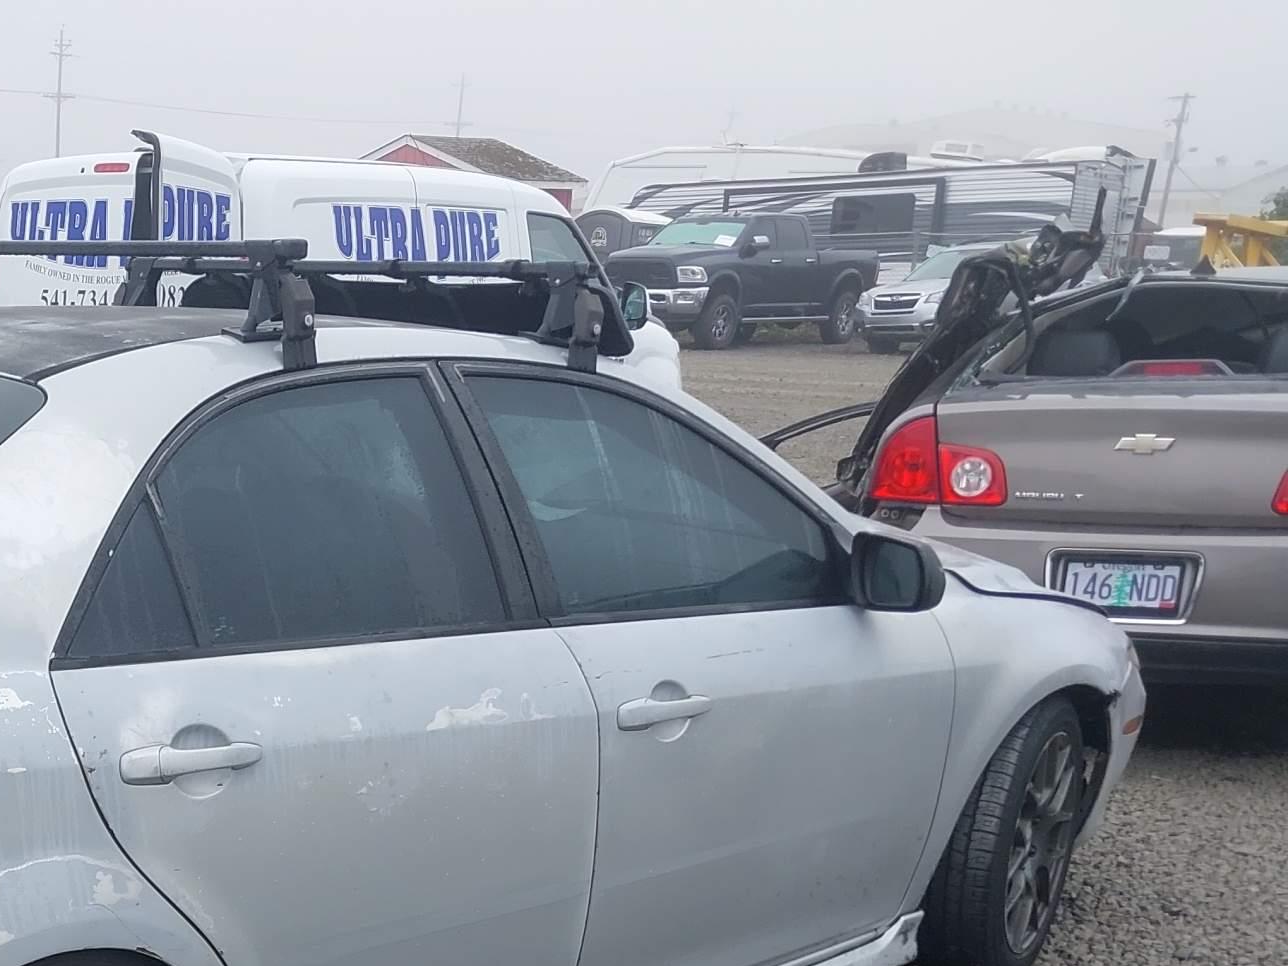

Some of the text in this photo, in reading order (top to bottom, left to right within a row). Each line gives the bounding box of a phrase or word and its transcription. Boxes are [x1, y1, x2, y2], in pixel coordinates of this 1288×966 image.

[11, 199, 108, 268] ULTRA
[331, 203, 502, 263] ULTRA PURE
[25, 259, 48, 276] FAMILY
[47, 268, 72, 281] OWNED
[72, 273, 81, 283] IN
[81, 275, 95, 285] THE
[96, 276, 120, 285] ROGUE
[1071, 571, 1177, 602] 146 NDD
